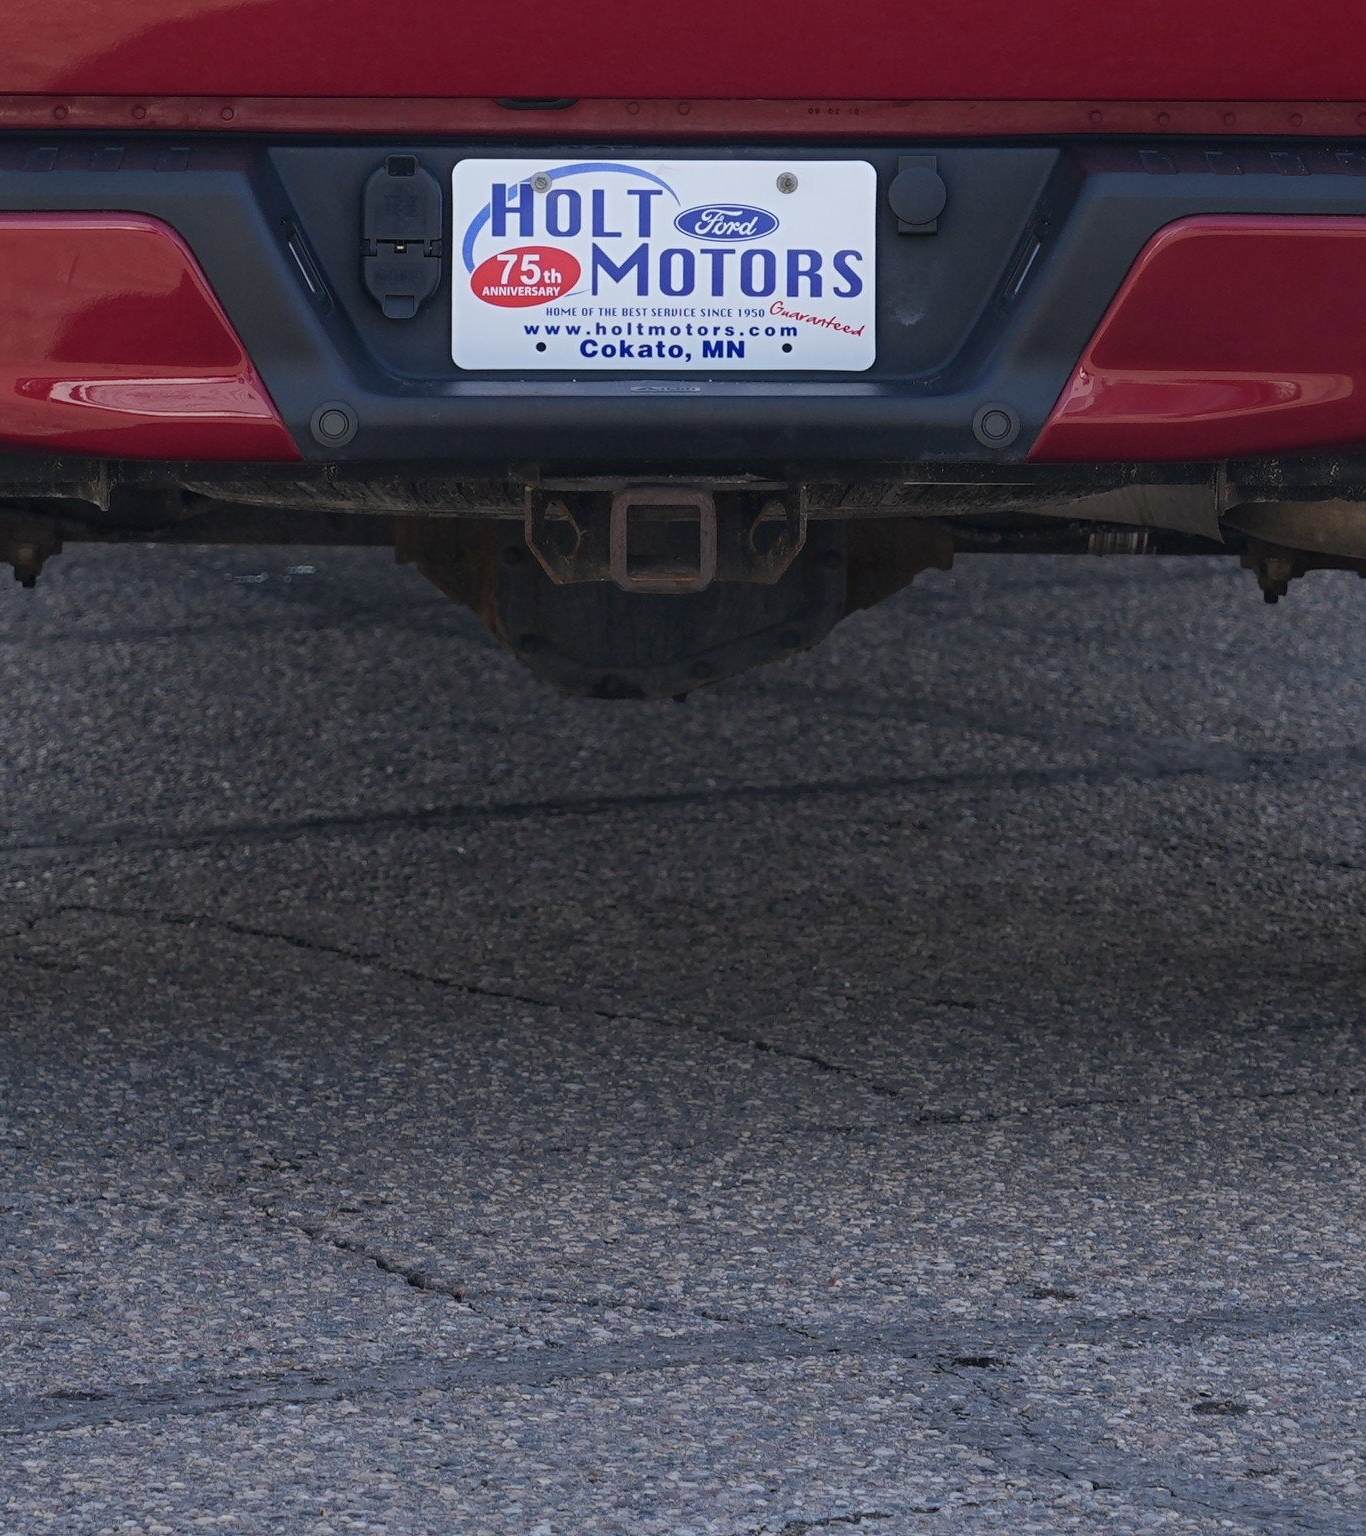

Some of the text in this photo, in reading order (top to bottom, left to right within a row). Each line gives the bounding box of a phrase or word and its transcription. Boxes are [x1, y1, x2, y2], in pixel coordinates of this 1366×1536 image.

[491, 182, 664, 238] HOLT
[693, 208, 759, 237] Ford
[496, 253, 563, 285] 75th
[591, 242, 864, 298] MOTORS
[481, 285, 561, 297] ANNIVERSARY
[546, 307, 766, 318] HOME OF THE BEST SERVICE SINCE 1950
[769, 300, 866, 337] Guaranteed
[523, 321, 798, 337] www.holtmotors.com
[579, 338, 746, 362] Cokato, MN
